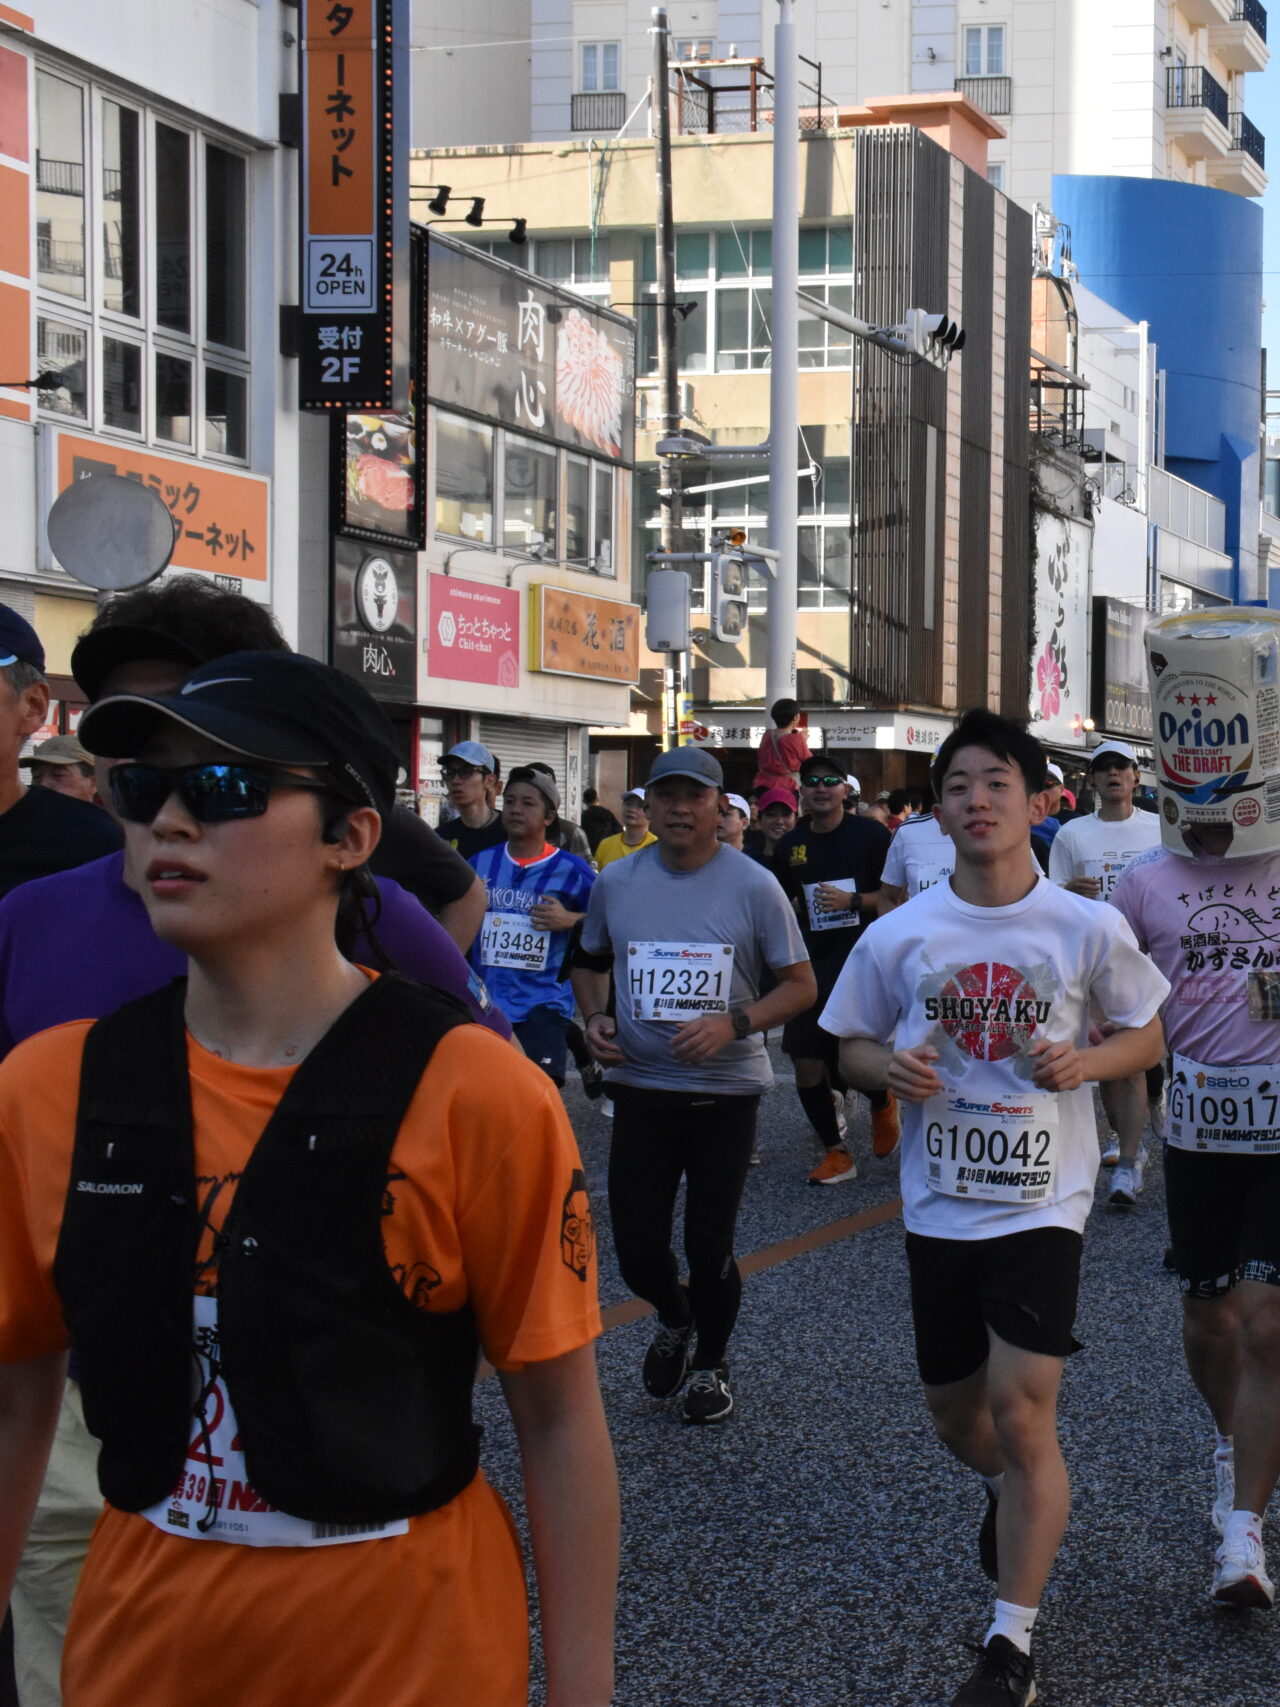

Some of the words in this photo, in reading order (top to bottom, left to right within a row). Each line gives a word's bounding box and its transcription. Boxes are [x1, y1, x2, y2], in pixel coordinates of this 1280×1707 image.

[325, 0, 356, 187] ターネット
[319, 253, 363, 278] 24h
[316, 280, 366, 295] OPEN
[318, 326, 363, 350] 受付
[321, 357, 361, 383] 2F
[515, 289, 546, 427] 肉心
[457, 614, 512, 641] ちっとちゃっと
[458, 638, 492, 652] Chit-chat
[363, 643, 393, 676] 肉心
[821, 726, 877, 735] ャッシュサービス
[1159, 708, 1249, 748] Orion
[1172, 754, 1191, 773] THE
[1193, 755, 1232, 773] DRAFT
[482, 929, 545, 954] H13484
[1180, 932, 1221, 949] 居酒屋
[630, 968, 722, 996] H12321
[925, 997, 1052, 1024] SHOYAKU
[1006, 1025, 1029, 1034] TEAM
[1206, 1076, 1250, 1088] sato
[955, 1098, 990, 1112] SUPER
[990, 1102, 1034, 1114] SPORTS
[1172, 1088, 1278, 1126] G10917
[926, 1122, 1050, 1167] G10042
[77, 1181, 144, 1194] SALOMON
[957, 1166, 986, 1184] 第39回
[985, 1170, 1051, 1187] NAHAマラソン
